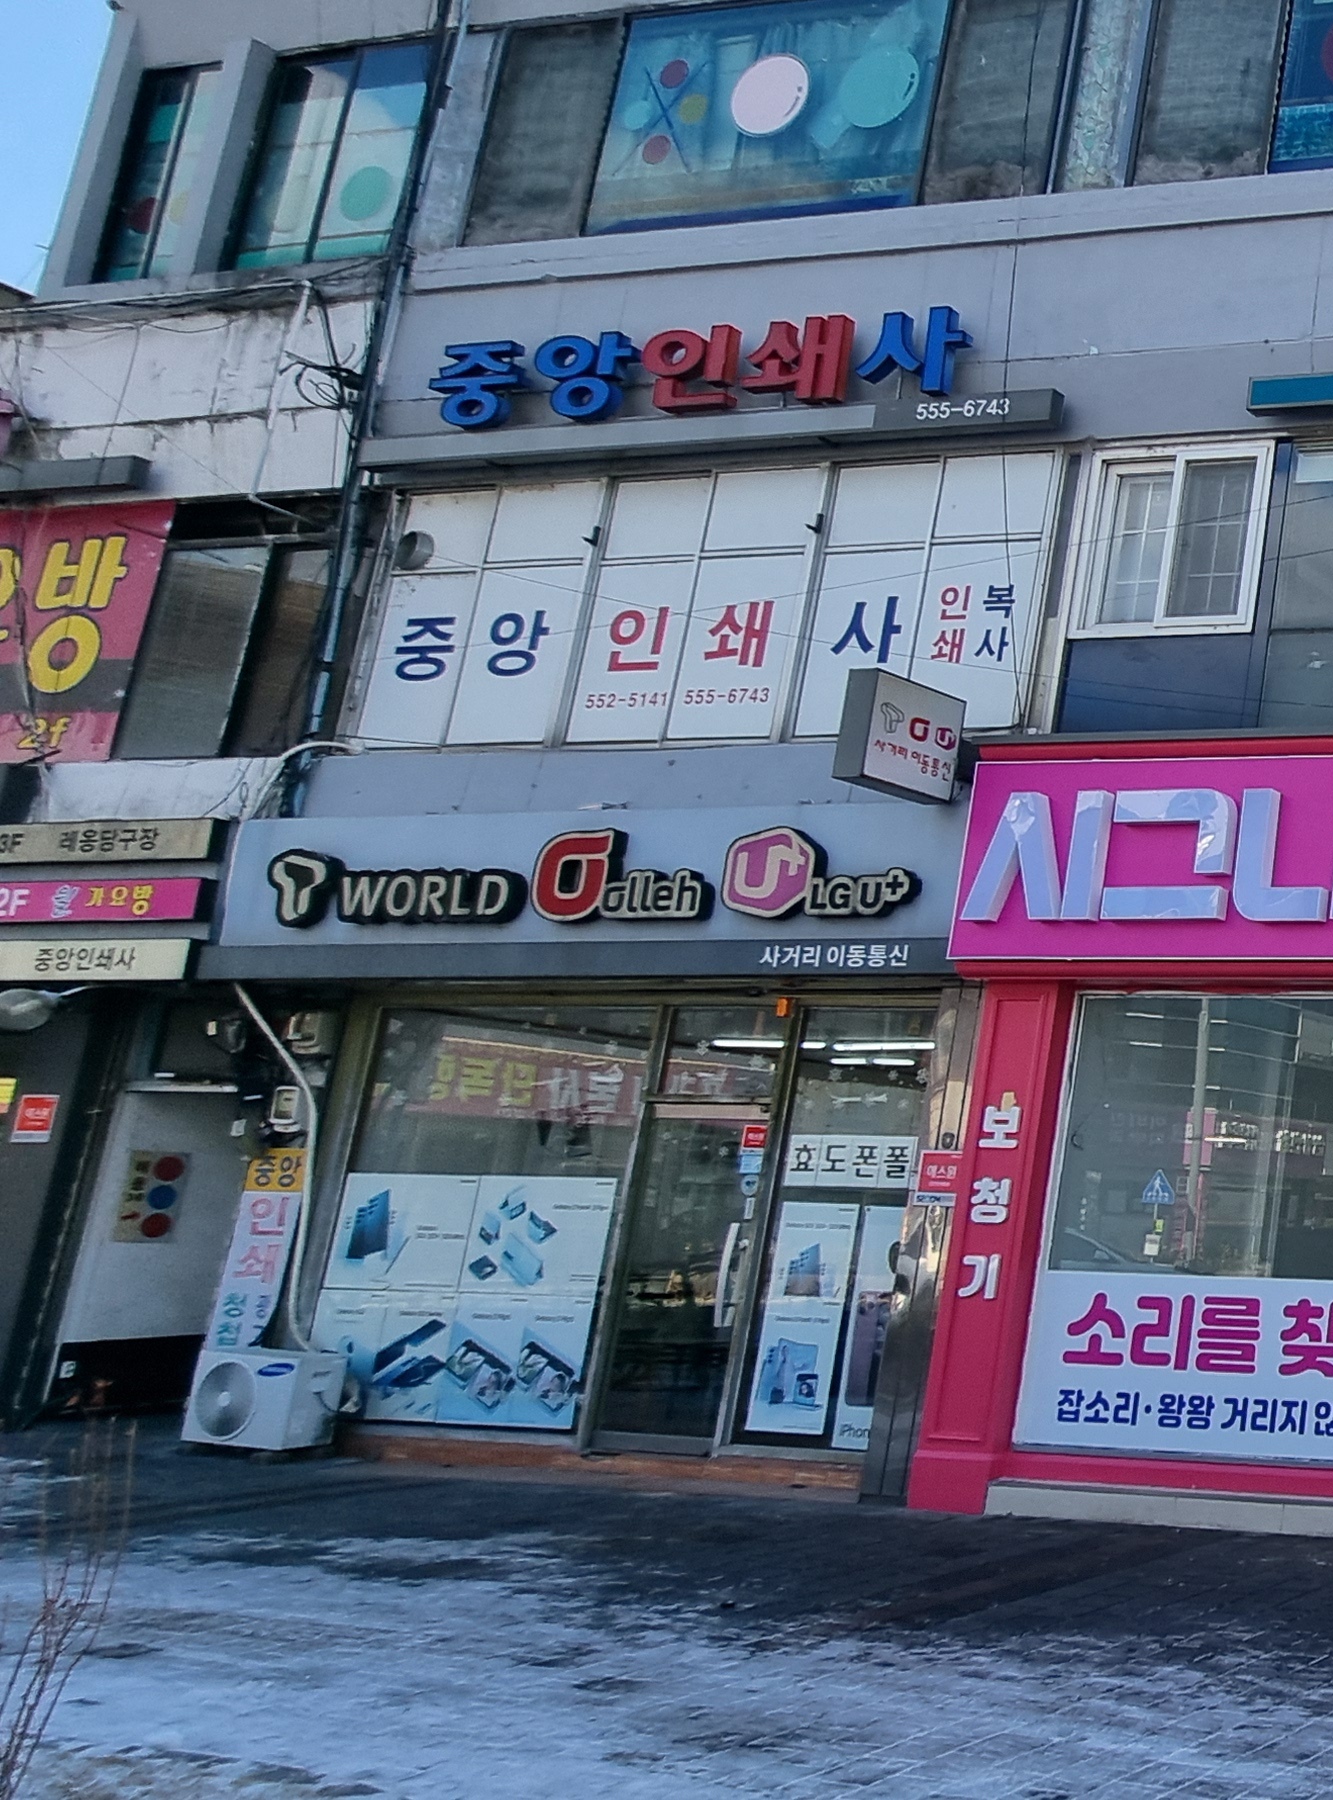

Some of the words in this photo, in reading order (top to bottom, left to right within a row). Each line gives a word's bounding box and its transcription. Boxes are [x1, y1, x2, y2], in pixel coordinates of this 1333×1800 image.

[428, 305, 974, 431] 중앙인쇄사
[915, 398, 1011, 421] 555-6743
[585, 691, 669, 710] 552-5141
[684, 686, 770, 706] 555-6743
[340, 873, 511, 918] WORLD
[35, 946, 136, 972] 중앙인쇄사
[759, 943, 821, 968] 사거리
[826, 942, 910, 969] 이동통신
[254, 1155, 302, 1188] 중앙
[958, 1106, 1022, 1300] 보청기
[1062, 1292, 1262, 1374] 소리를
[839, 1423, 871, 1439] iPhon
[1220, 1397, 1308, 1435] 거리지
